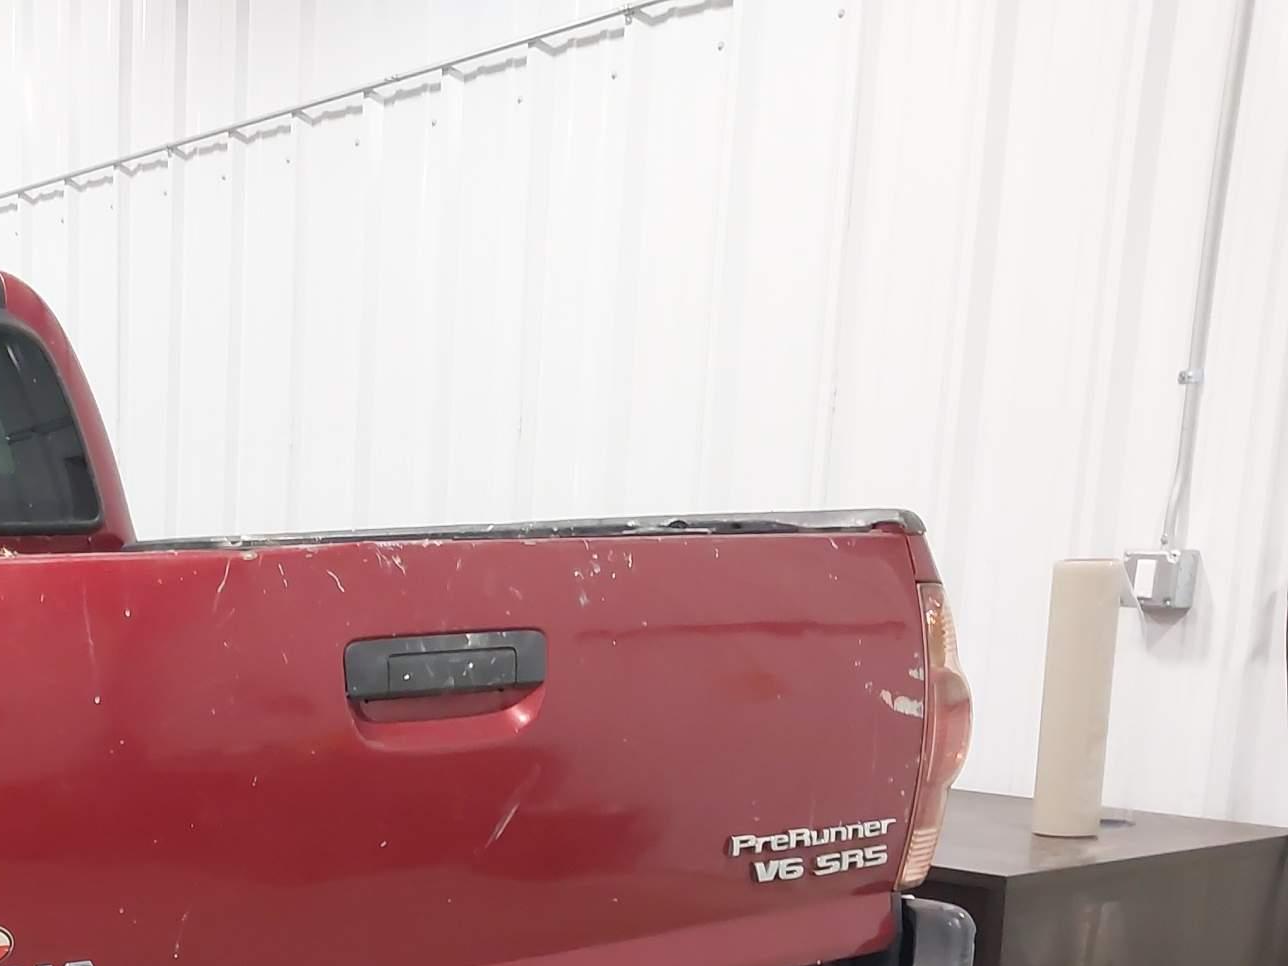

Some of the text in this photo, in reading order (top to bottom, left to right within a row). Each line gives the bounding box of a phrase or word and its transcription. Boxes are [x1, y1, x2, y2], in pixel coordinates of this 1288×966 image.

[730, 818, 896, 857] PreRunner
[753, 845, 888, 882] V6 SR5
